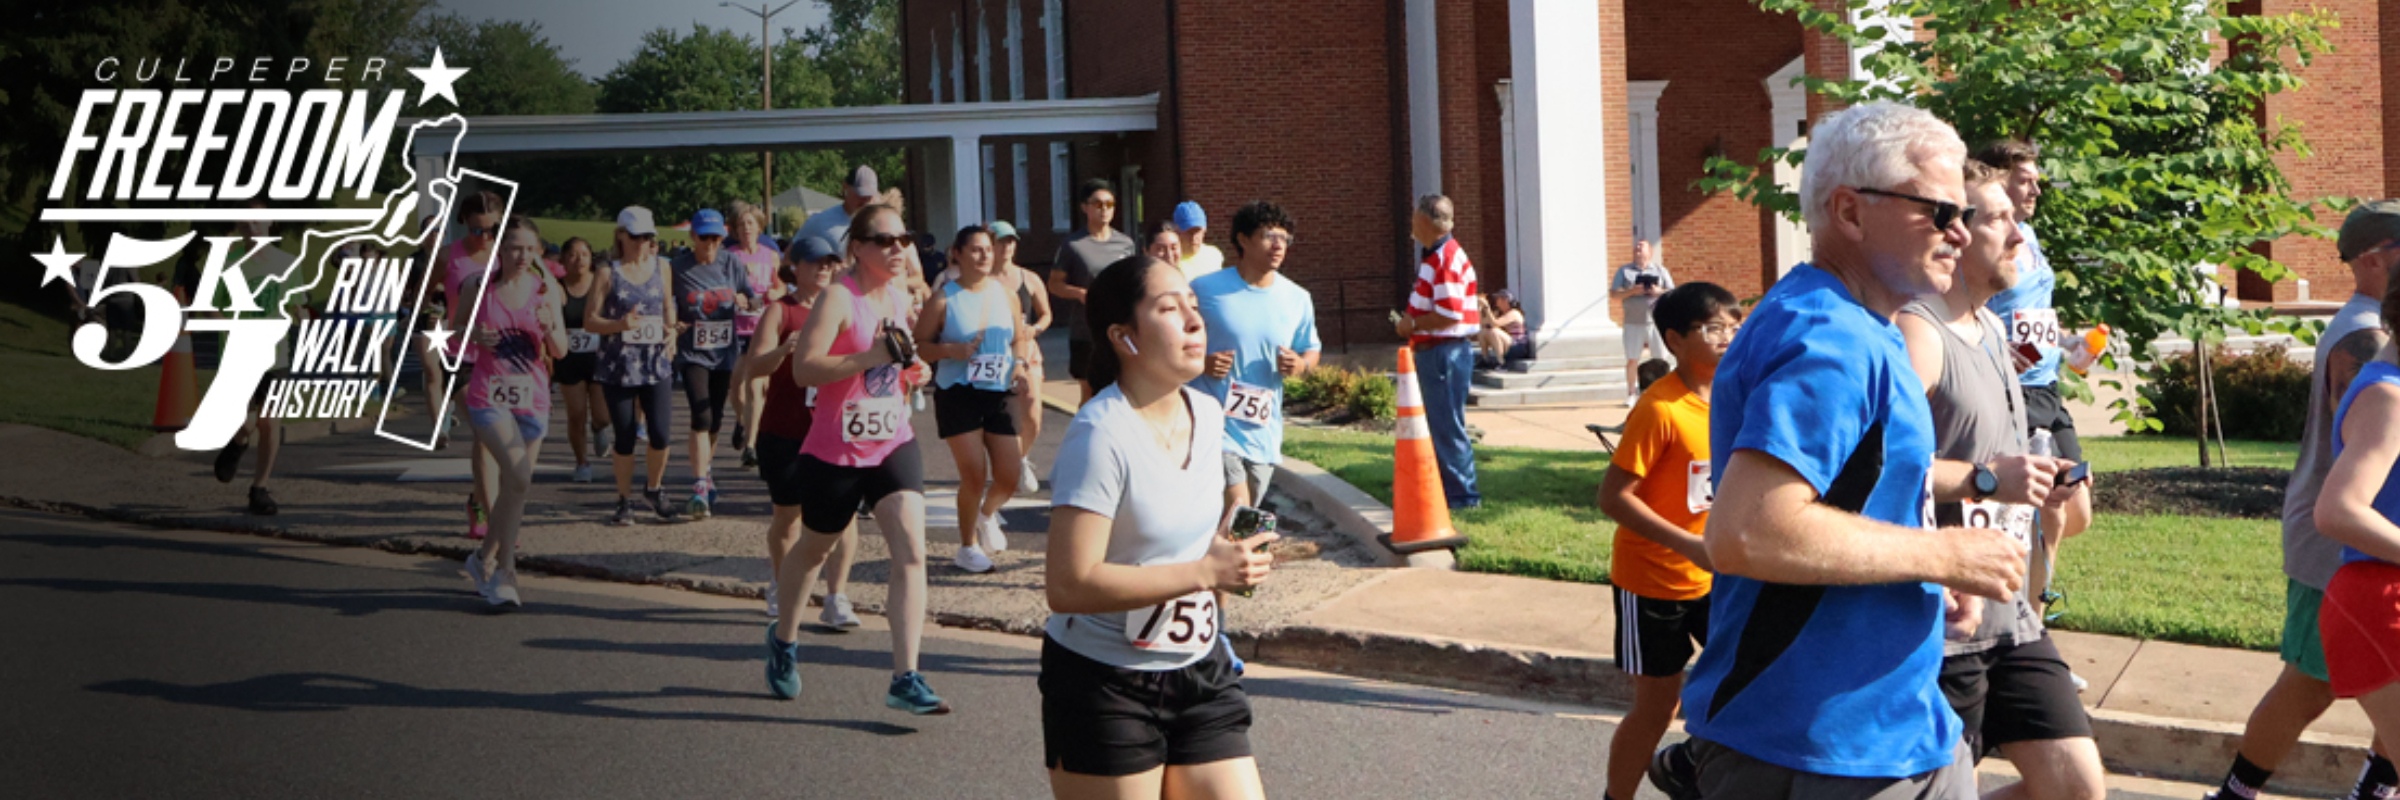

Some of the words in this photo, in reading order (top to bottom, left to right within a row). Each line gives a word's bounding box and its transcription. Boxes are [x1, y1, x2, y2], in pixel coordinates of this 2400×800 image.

[697, 328, 729, 344] 854
[2016, 321, 2056, 343] 996
[1230, 392, 1270, 421] 756
[1136, 600, 1214, 644] 753
